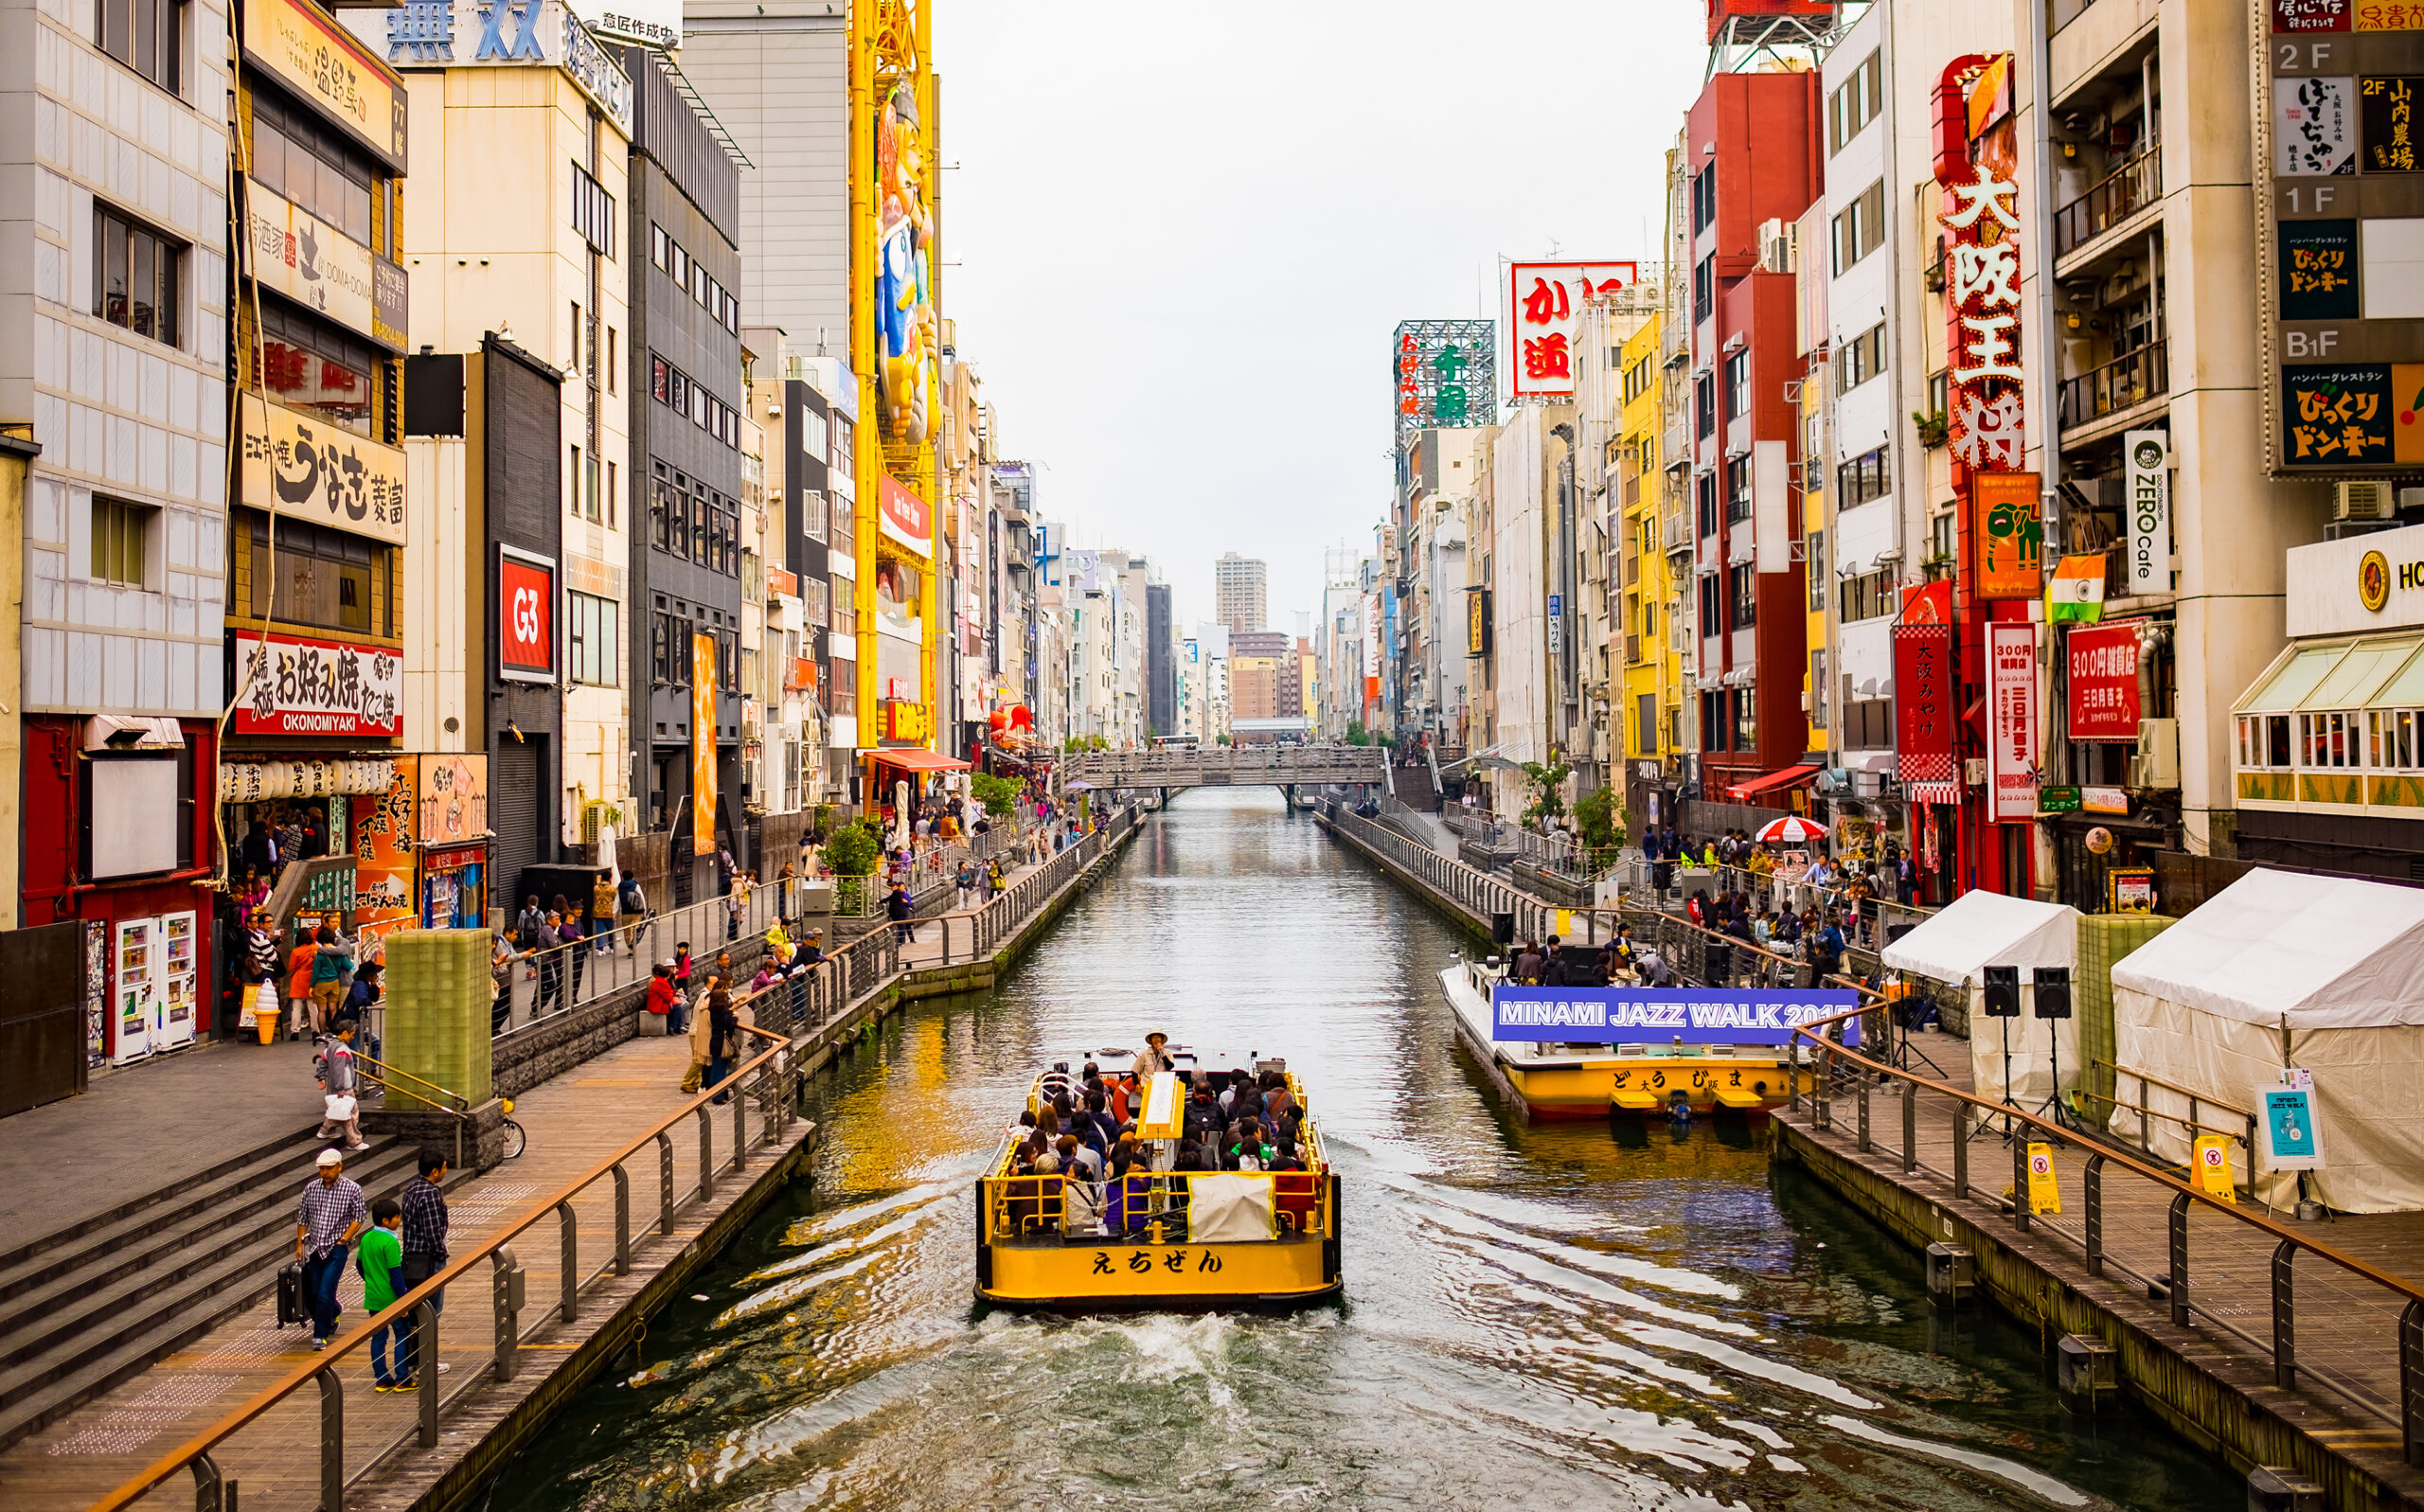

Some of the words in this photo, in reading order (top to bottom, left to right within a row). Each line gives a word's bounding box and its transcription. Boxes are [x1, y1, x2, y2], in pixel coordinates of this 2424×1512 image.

[602, 11, 673, 39] 意匠作成中
[2288, 17, 2335, 28] 鉄板料理
[2362, 80, 2386, 96] 2F
[2389, 79, 2415, 170] 山内農場
[2341, 164, 2355, 174] 2F
[2291, 248, 2345, 271] びっくり
[2290, 271, 2348, 294] ドンキー
[1941, 163, 2024, 470] 大阪王将
[2287, 330, 2339, 358] B1F
[1399, 332, 1419, 416] お好み焼
[1433, 344, 1469, 418] 千房
[2291, 372, 2383, 382] ハンバーグレストラン
[2295, 389, 2379, 425] びっくり
[2291, 425, 2387, 459] ドンキー
[275, 423, 368, 522] うなぎ
[2135, 473, 2157, 534] ZERO
[2137, 536, 2152, 578] cafe
[513, 586, 540, 646] G3
[1997, 645, 2032, 657] 300円
[276, 647, 360, 711] お好み焼
[1916, 641, 1935, 738] 大阪みやげ
[360, 678, 396, 728] たこ焼
[2082, 687, 2125, 708] 三日月百子
[283, 714, 356, 732] OKONOMIYAKI
[2012, 686, 2028, 762] 三日月百子
[391, 773, 413, 854] お好み焼
[1499, 1000, 1607, 1026] MINAMI
[1609, 1001, 1686, 1028] JAZZ
[1687, 1003, 1784, 1029] WALK
[1613, 1070, 1742, 1090] どうじま
[1092, 1250, 1223, 1275] えちぜん
